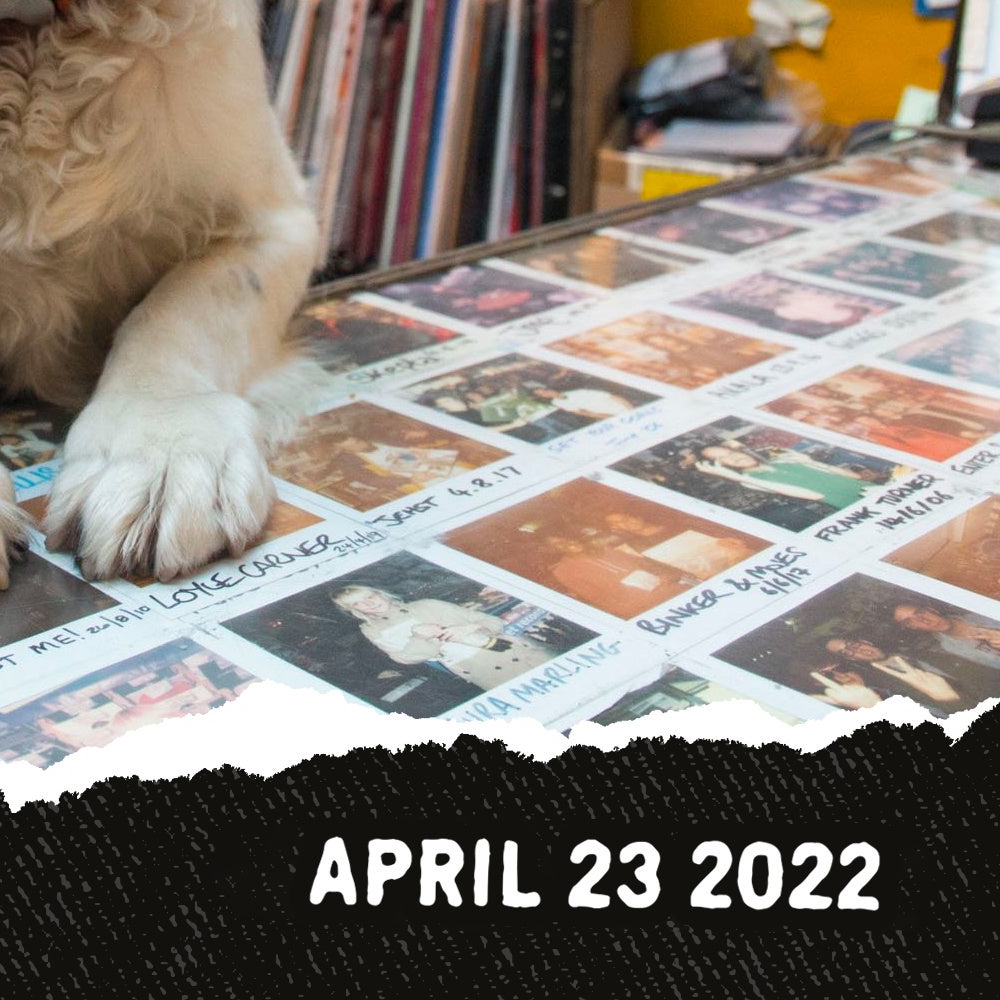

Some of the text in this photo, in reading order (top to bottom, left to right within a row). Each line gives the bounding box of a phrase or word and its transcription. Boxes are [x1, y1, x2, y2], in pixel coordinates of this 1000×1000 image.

[448, 465, 522, 497] 4.8.17
[814, 473, 944, 542] FRANK TURNER
[149, 572, 244, 610] LOYLE
[238, 534, 346, 579] CARNER
[636, 588, 735, 636] BINKER
[724, 578, 760, 592] &
[28, 627, 86, 655] ME!
[510, 640, 622, 703] MARLING
